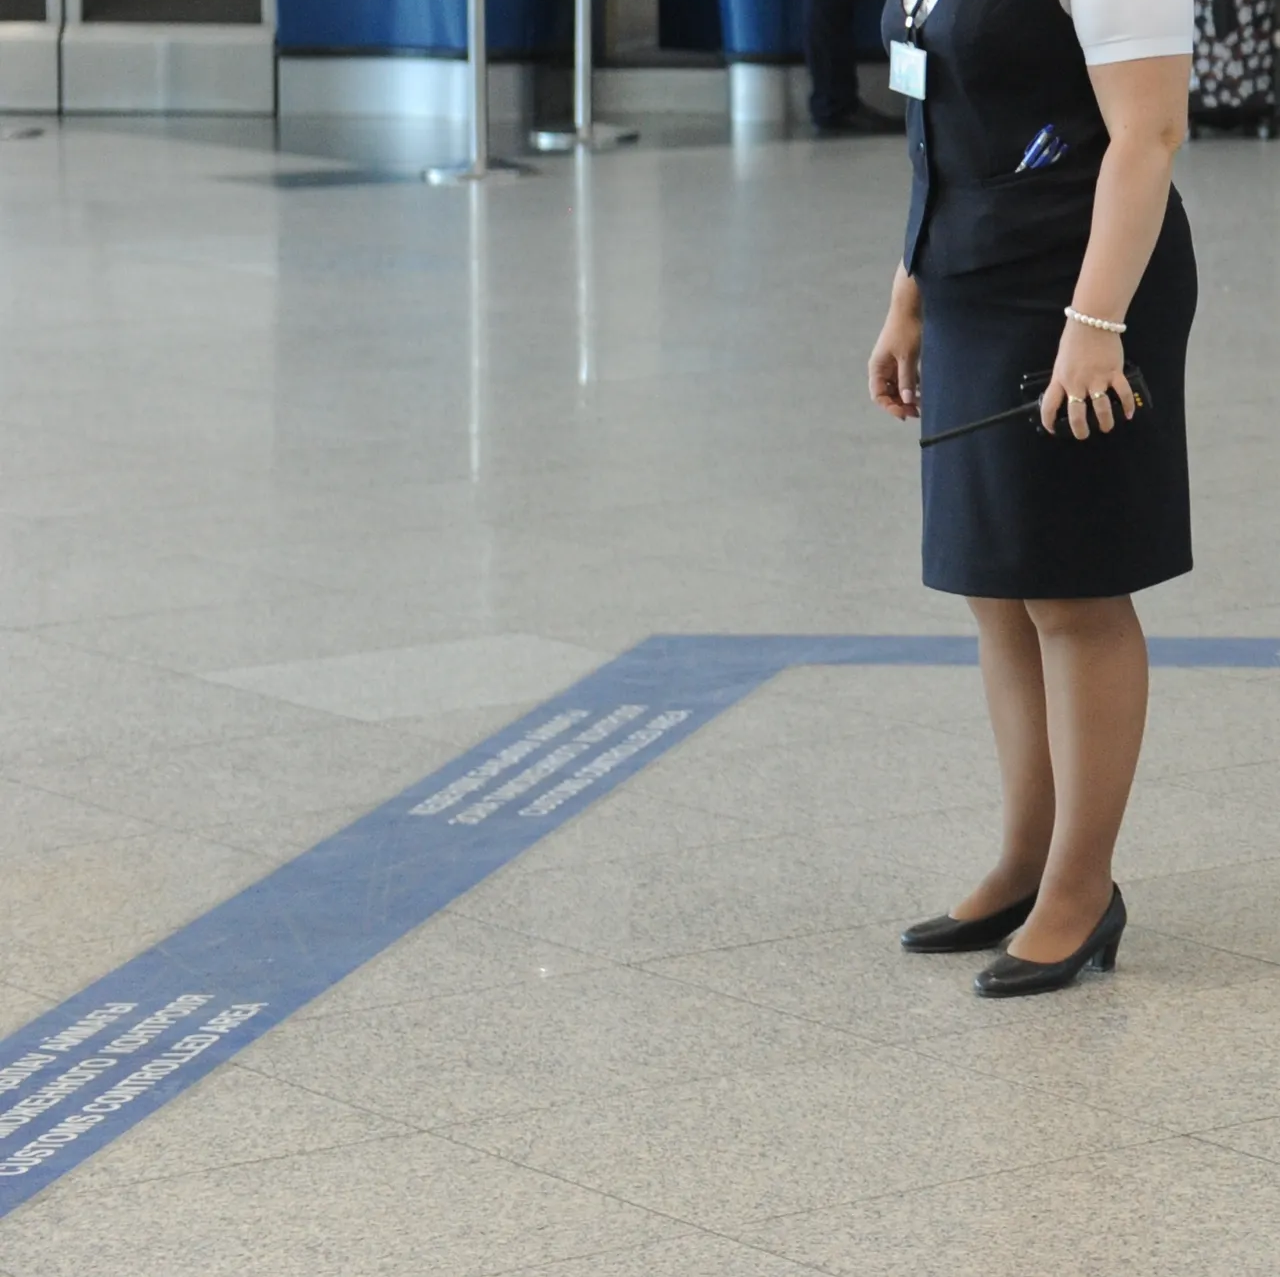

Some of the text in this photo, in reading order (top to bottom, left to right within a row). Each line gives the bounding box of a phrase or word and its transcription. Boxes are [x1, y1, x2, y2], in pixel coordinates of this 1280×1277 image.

[0, 994, 216, 1139] МОЖЕННОГО КОНТРОЛЯ
[0, 1002, 270, 1176] CUSTOMS CONTROLLED AREA
